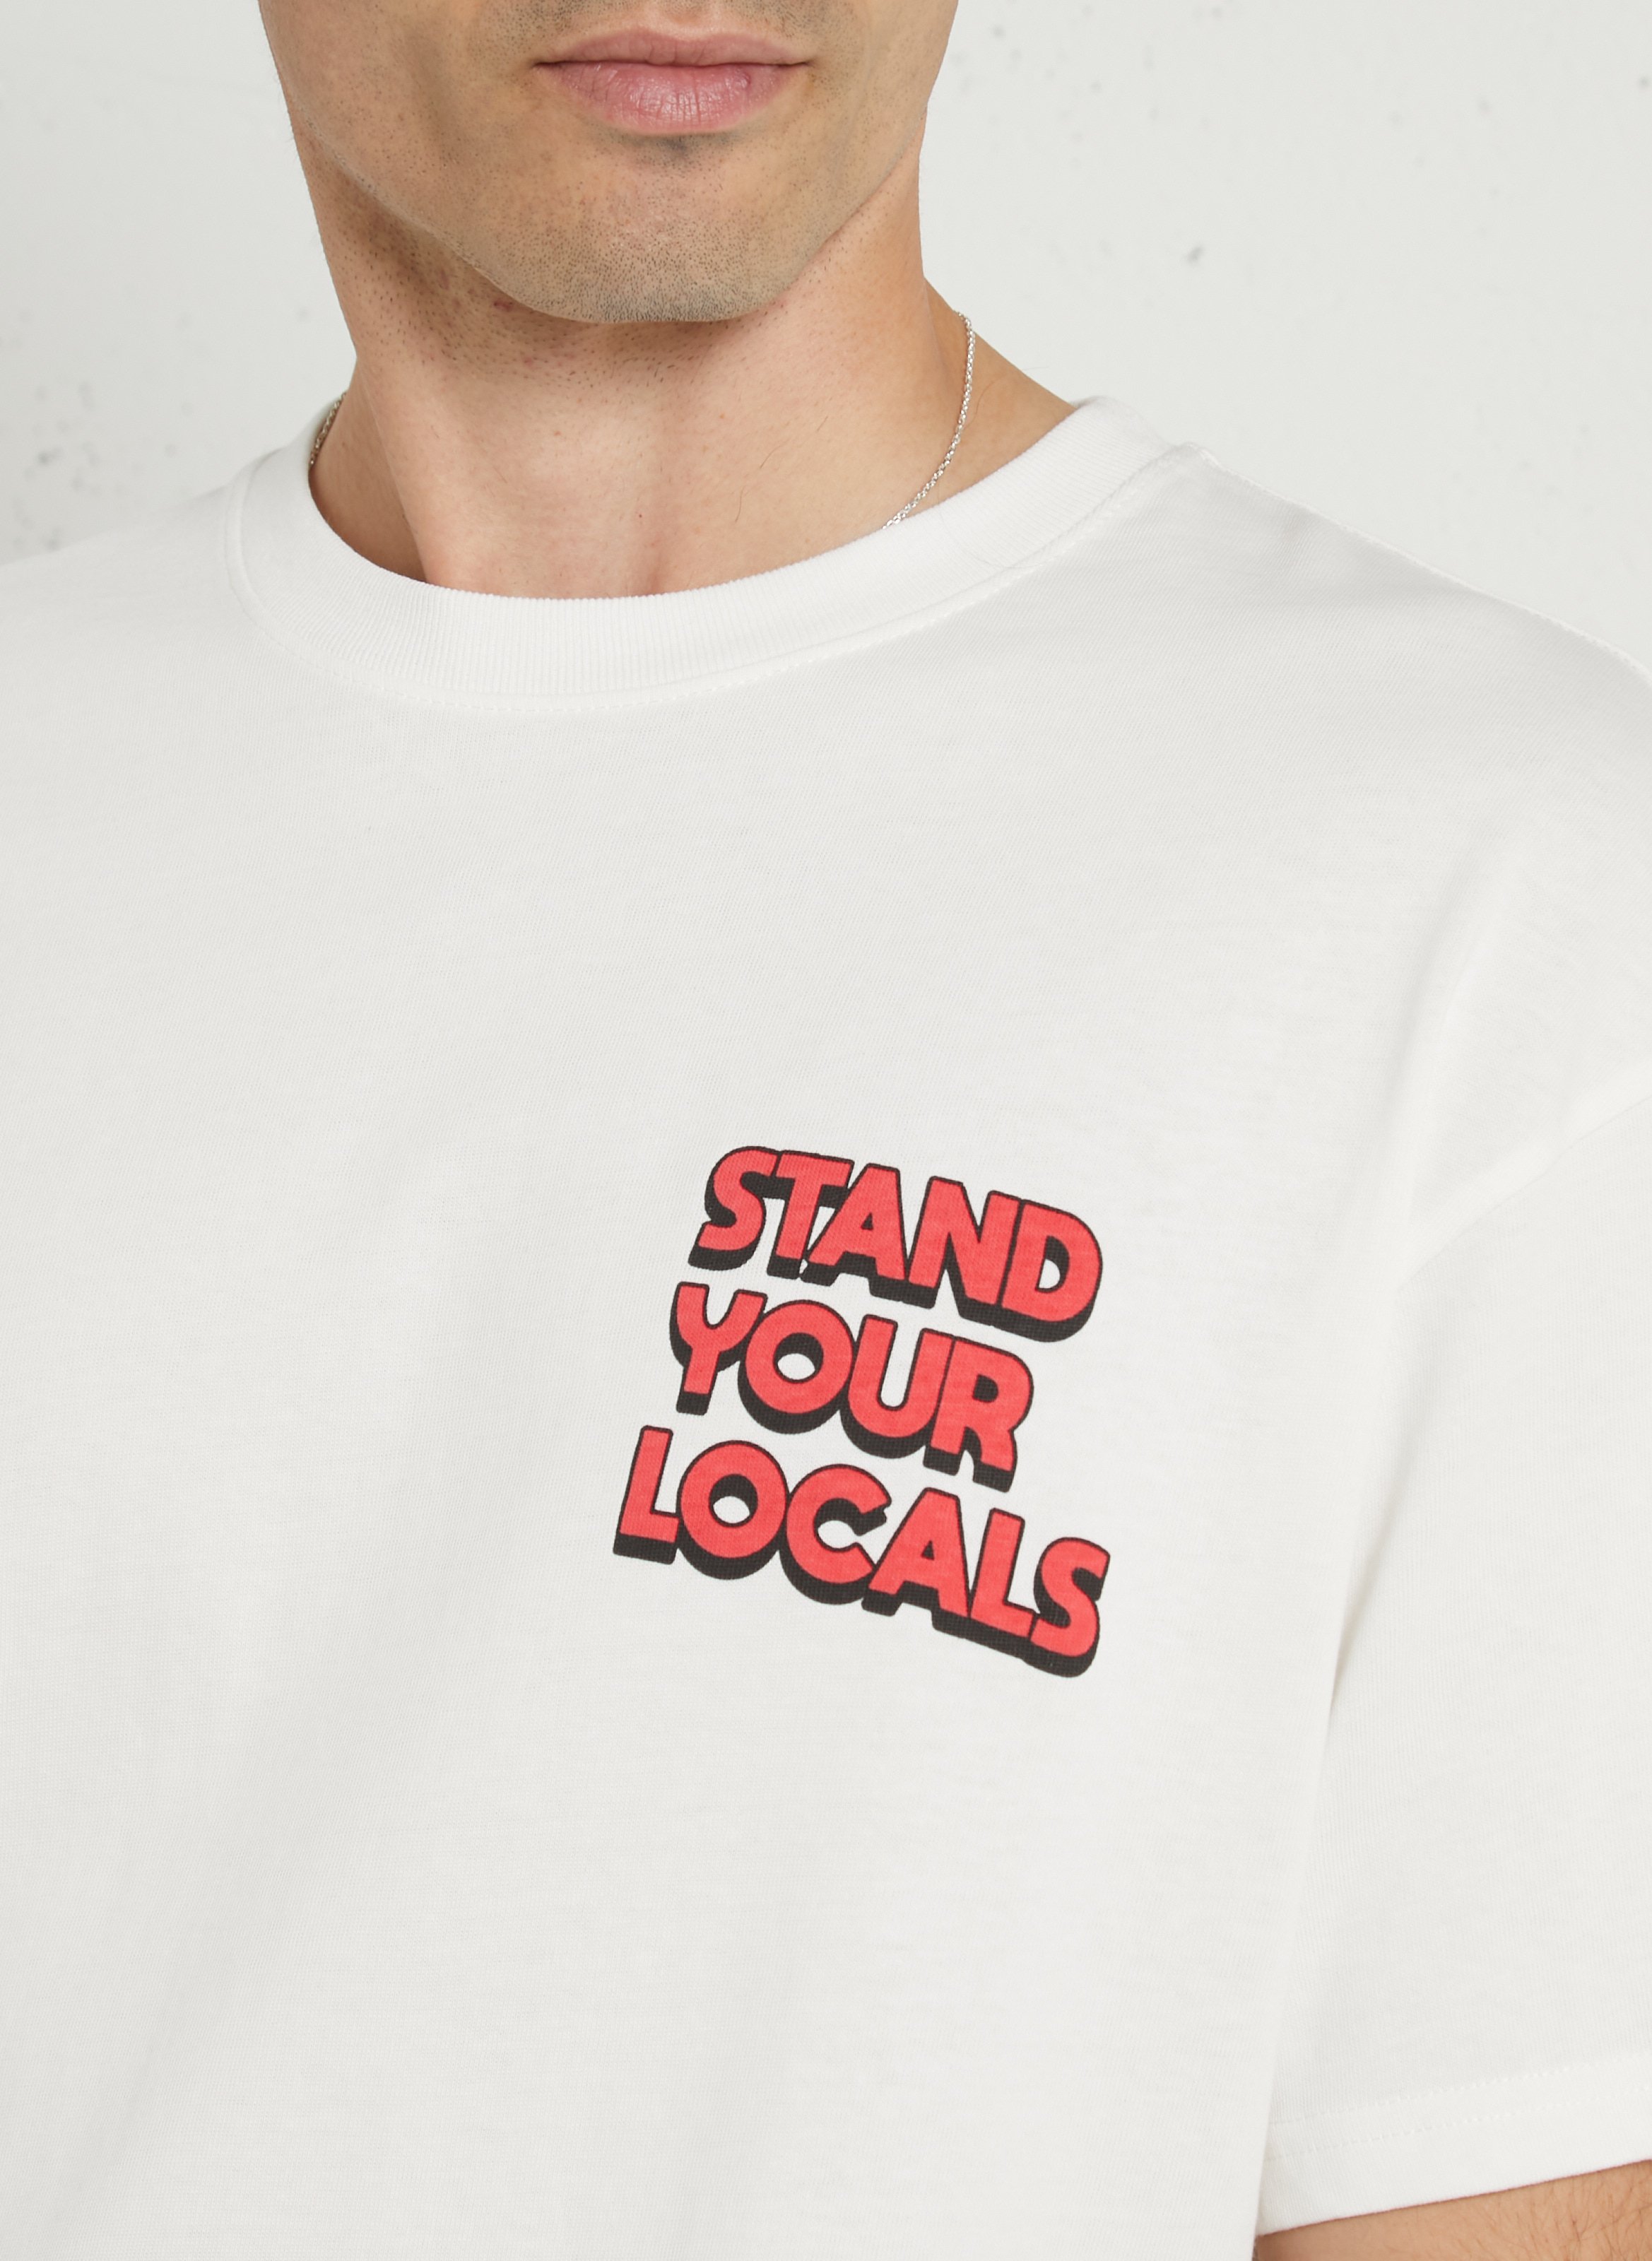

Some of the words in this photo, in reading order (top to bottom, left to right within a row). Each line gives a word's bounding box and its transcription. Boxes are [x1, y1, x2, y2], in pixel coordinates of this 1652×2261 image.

[688, 1146, 1102, 1342] STAND
[669, 1282, 1034, 1492] YOUR
[613, 1425, 1110, 1677] LOCALS
